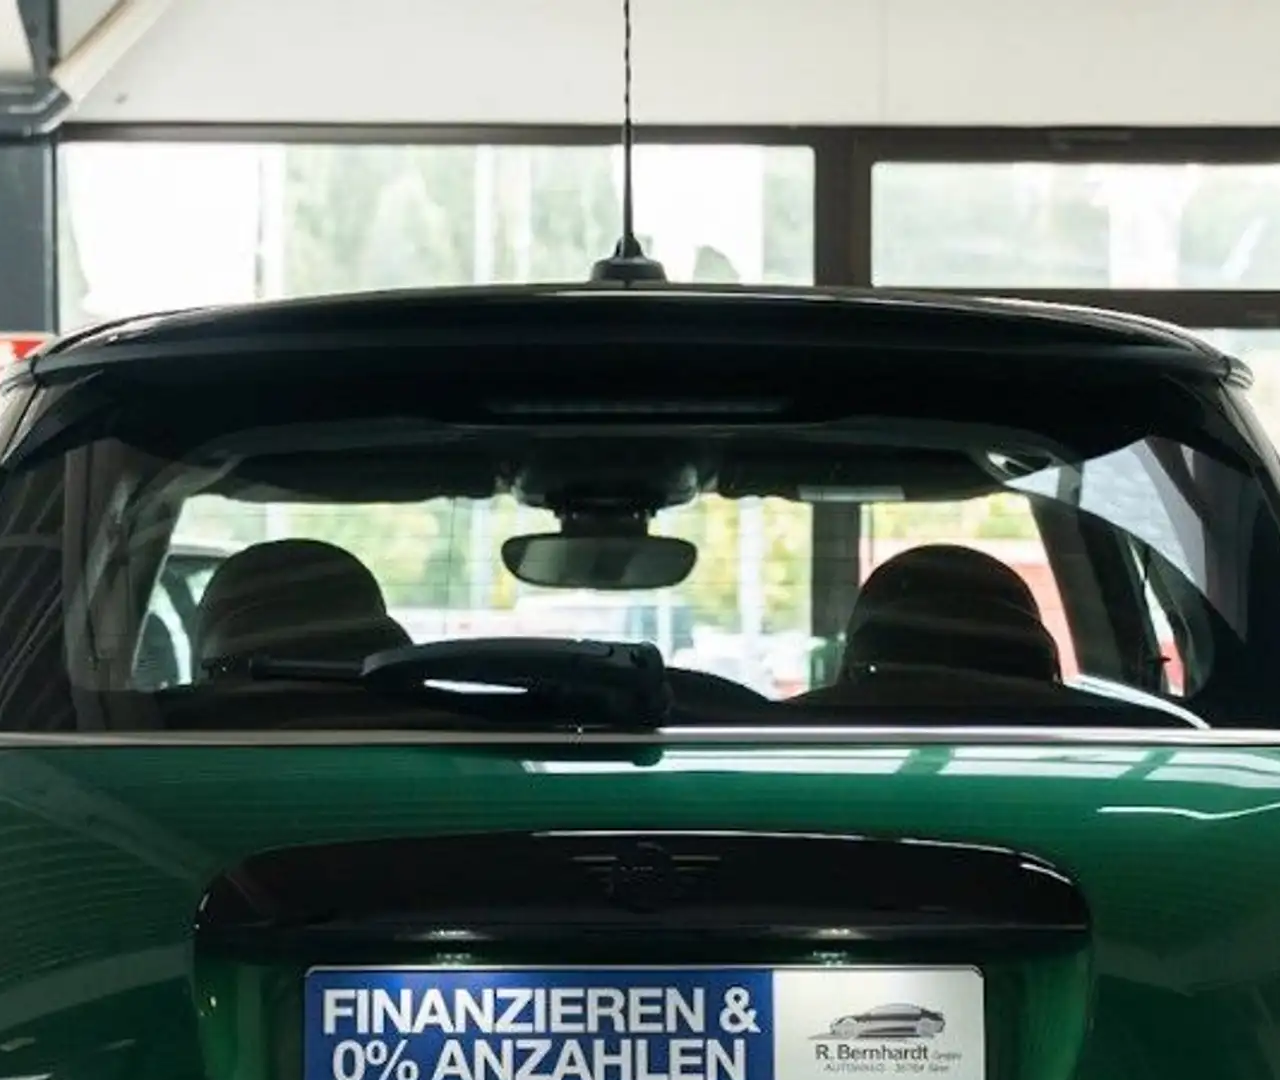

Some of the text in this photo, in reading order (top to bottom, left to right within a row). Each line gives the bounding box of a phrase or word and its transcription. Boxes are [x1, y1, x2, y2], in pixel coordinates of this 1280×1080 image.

[323, 986, 761, 1034] FINANZIEREN &
[815, 1044, 835, 1060] R.
[837, 1044, 929, 1060] Bernhardt
